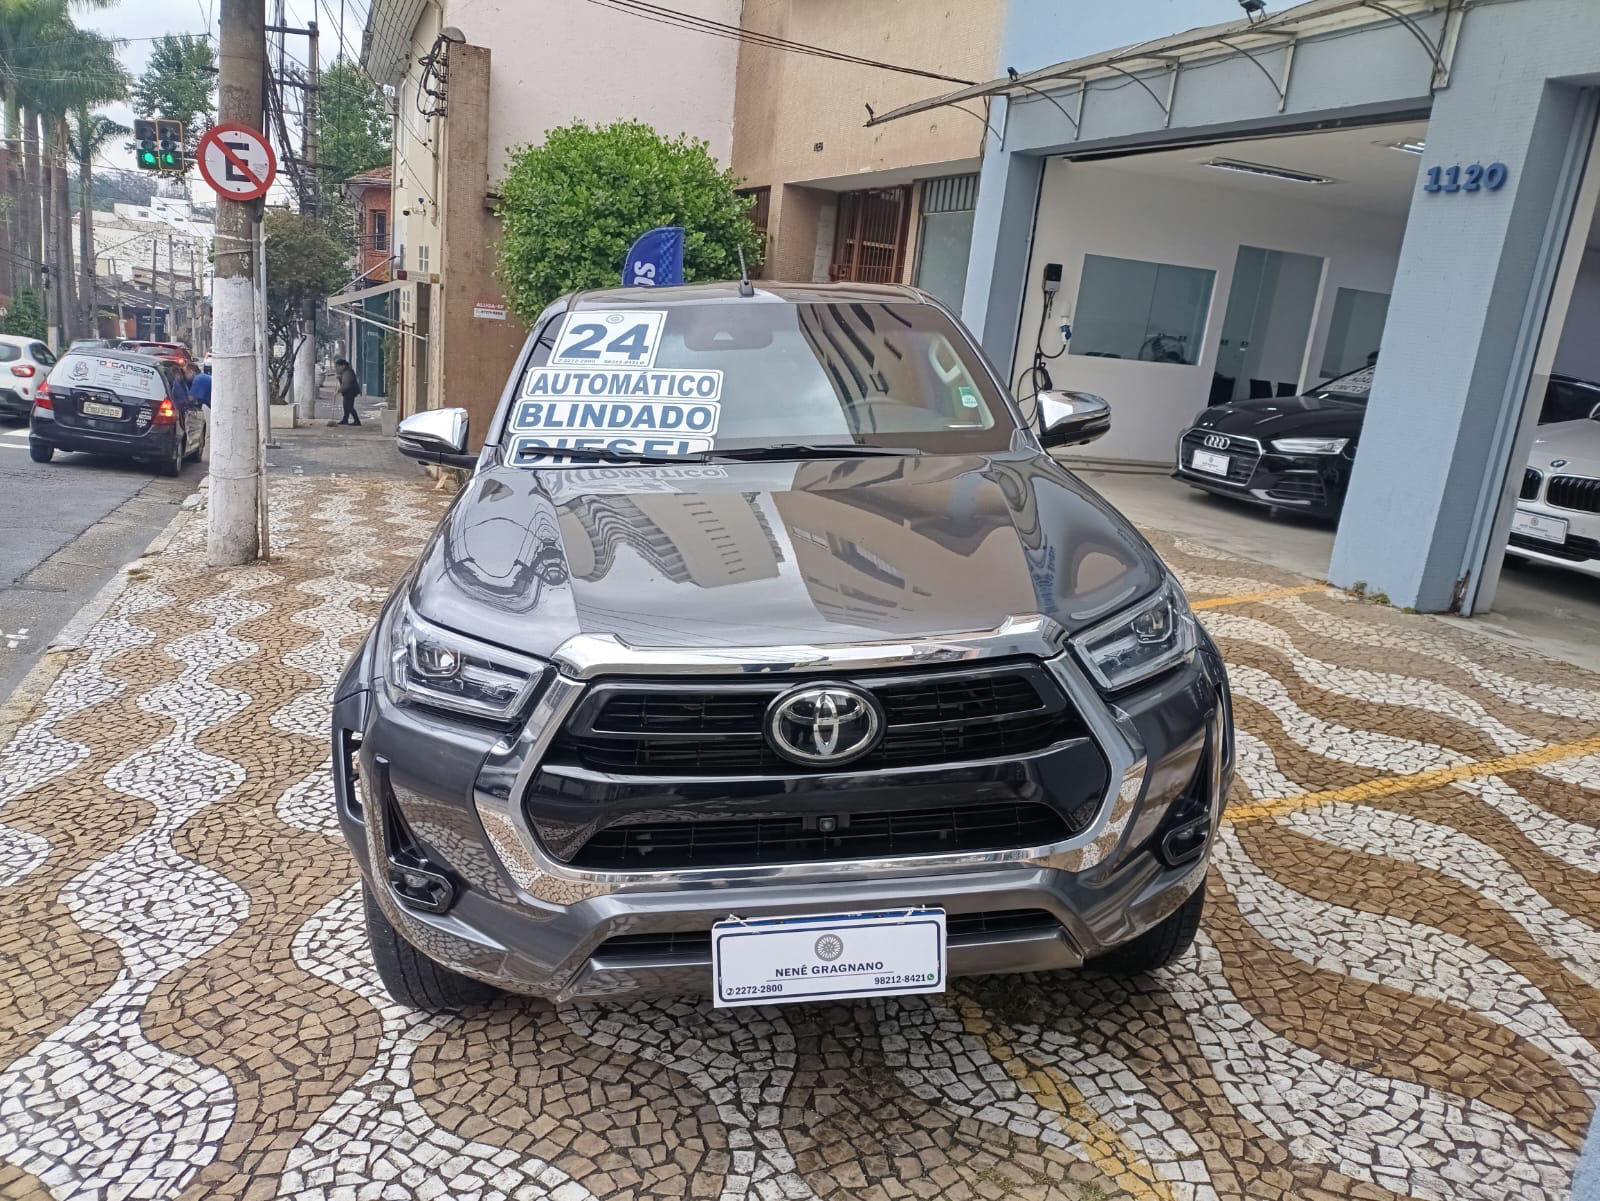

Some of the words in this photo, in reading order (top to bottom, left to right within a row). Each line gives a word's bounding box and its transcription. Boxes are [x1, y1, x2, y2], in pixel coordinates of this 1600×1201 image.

[224, 142, 251, 182] E
[1424, 162, 1507, 191] 1120
[559, 323, 649, 360] 24
[529, 371, 716, 397] AUTOMÁTICO
[516, 403, 712, 431] BLINDADO
[775, 964, 808, 977] NENÉ
[811, 961, 884, 974] GRAGNANO
[874, 974, 926, 985] 98212-8421
[735, 984, 783, 995] 2272-2800
